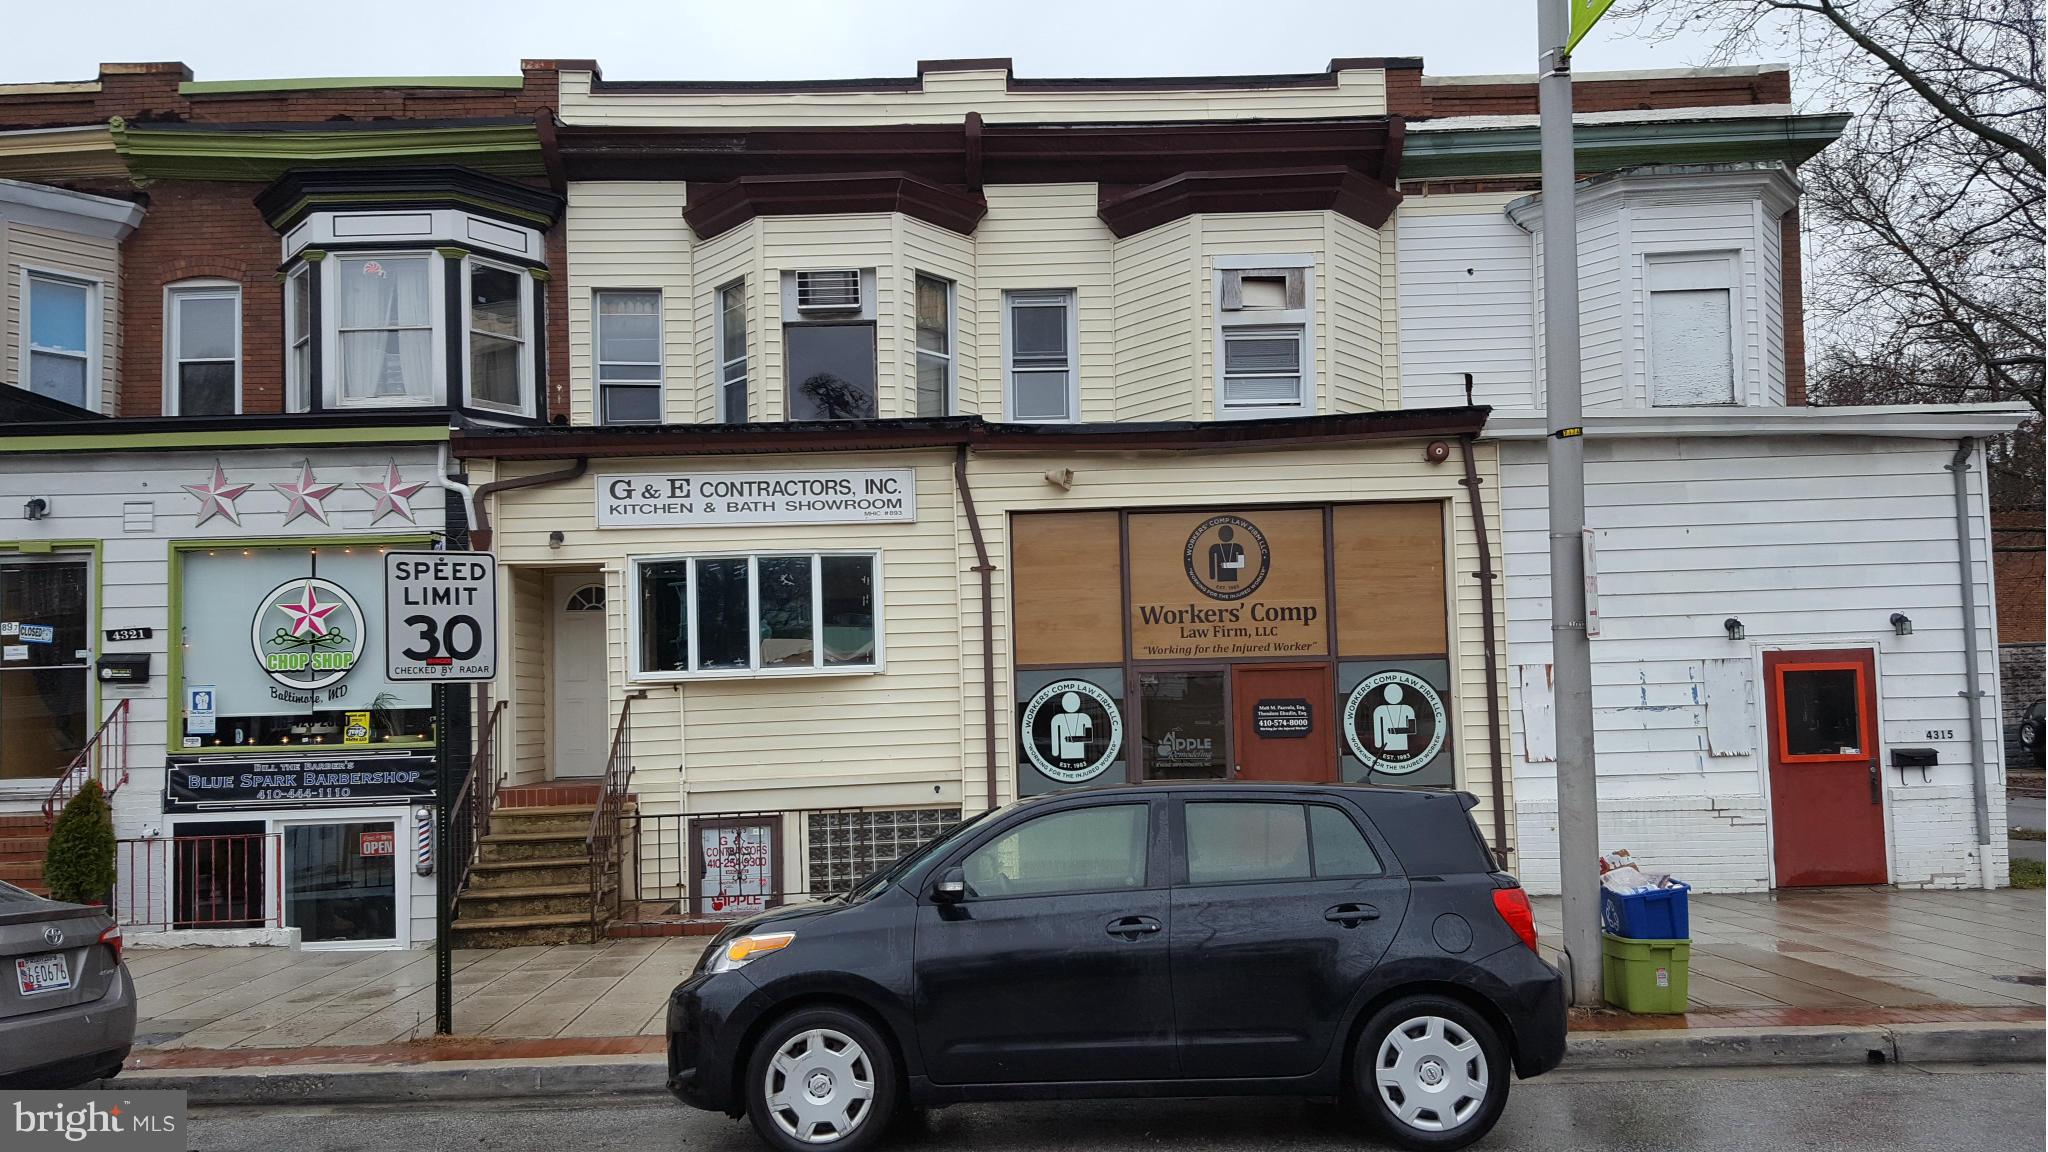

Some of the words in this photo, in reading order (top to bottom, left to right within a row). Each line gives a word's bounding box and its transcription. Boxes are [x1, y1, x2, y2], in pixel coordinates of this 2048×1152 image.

[609, 480, 636, 500] G
[641, 484, 661, 499] &
[667, 478, 690, 498] E
[699, 479, 856, 498] CONTRACTORS,
[865, 478, 901, 495] INC.
[609, 502, 693, 515] KITCHEN
[704, 502, 716, 513] &
[727, 501, 775, 513] BATH
[785, 499, 902, 512] SHOWROOM
[1209, 517, 1230, 526] COMP
[1231, 518, 1248, 528] LAW
[1248, 526, 1262, 540] FIRM
[1259, 540, 1268, 554] LLC
[395, 561, 486, 581] SPEED
[404, 587, 478, 606] LIMIT
[1139, 603, 1244, 625] Workers'
[1250, 603, 1317, 626] Comp
[20, 627, 42, 637] CLOSED
[112, 629, 146, 641] 4321
[402, 614, 482, 661] 30
[1180, 627, 1208, 639] Law
[1213, 625, 1251, 638] Firm,
[1255, 626, 1278, 637] LLC
[1194, 644, 1210, 655] for
[1212, 643, 1229, 653] the
[1231, 642, 1270, 654] Injured
[267, 652, 309, 672] CHOP
[311, 651, 354, 672] SHOP
[395, 666, 436, 675] CHECKED
[441, 666, 453, 675] BY
[459, 665, 489, 673] RADAR
[269, 686, 323, 704] Baltimore,
[328, 684, 348, 701] MD
[1347, 681, 1371, 720] WORKERS'
[1373, 675, 1397, 685] COMP
[1399, 675, 1419, 687] LAW
[1419, 684, 1436, 702] FIRM
[1433, 702, 1442, 718] LLC
[1025, 690, 1050, 728] WORKERS'
[1051, 683, 1075, 693] COMP
[1077, 684, 1096, 695] LAW
[1096, 693, 1112, 711] FIRM
[1109, 710, 1119, 726] LLC
[1258, 718, 1308, 727] 410-574-8000
[1163, 731, 1212, 751] APPLE
[1926, 730, 1953, 740] 4315
[254, 763, 277, 772] BILL
[280, 763, 300, 771] THE
[304, 760, 354, 771] BARBER'S
[1048, 767, 1061, 776] FOR
[1075, 766, 1100, 778] INJURED
[1399, 758, 1424, 770] INJURED
[188, 775, 234, 789] BLUE
[240, 773, 297, 788] SPARK
[303, 771, 420, 786] BARBERSHOP
[257, 787, 351, 800] 410-444-1110
[363, 842, 393, 854] OPEN
[714, 889, 762, 907] APPLE
